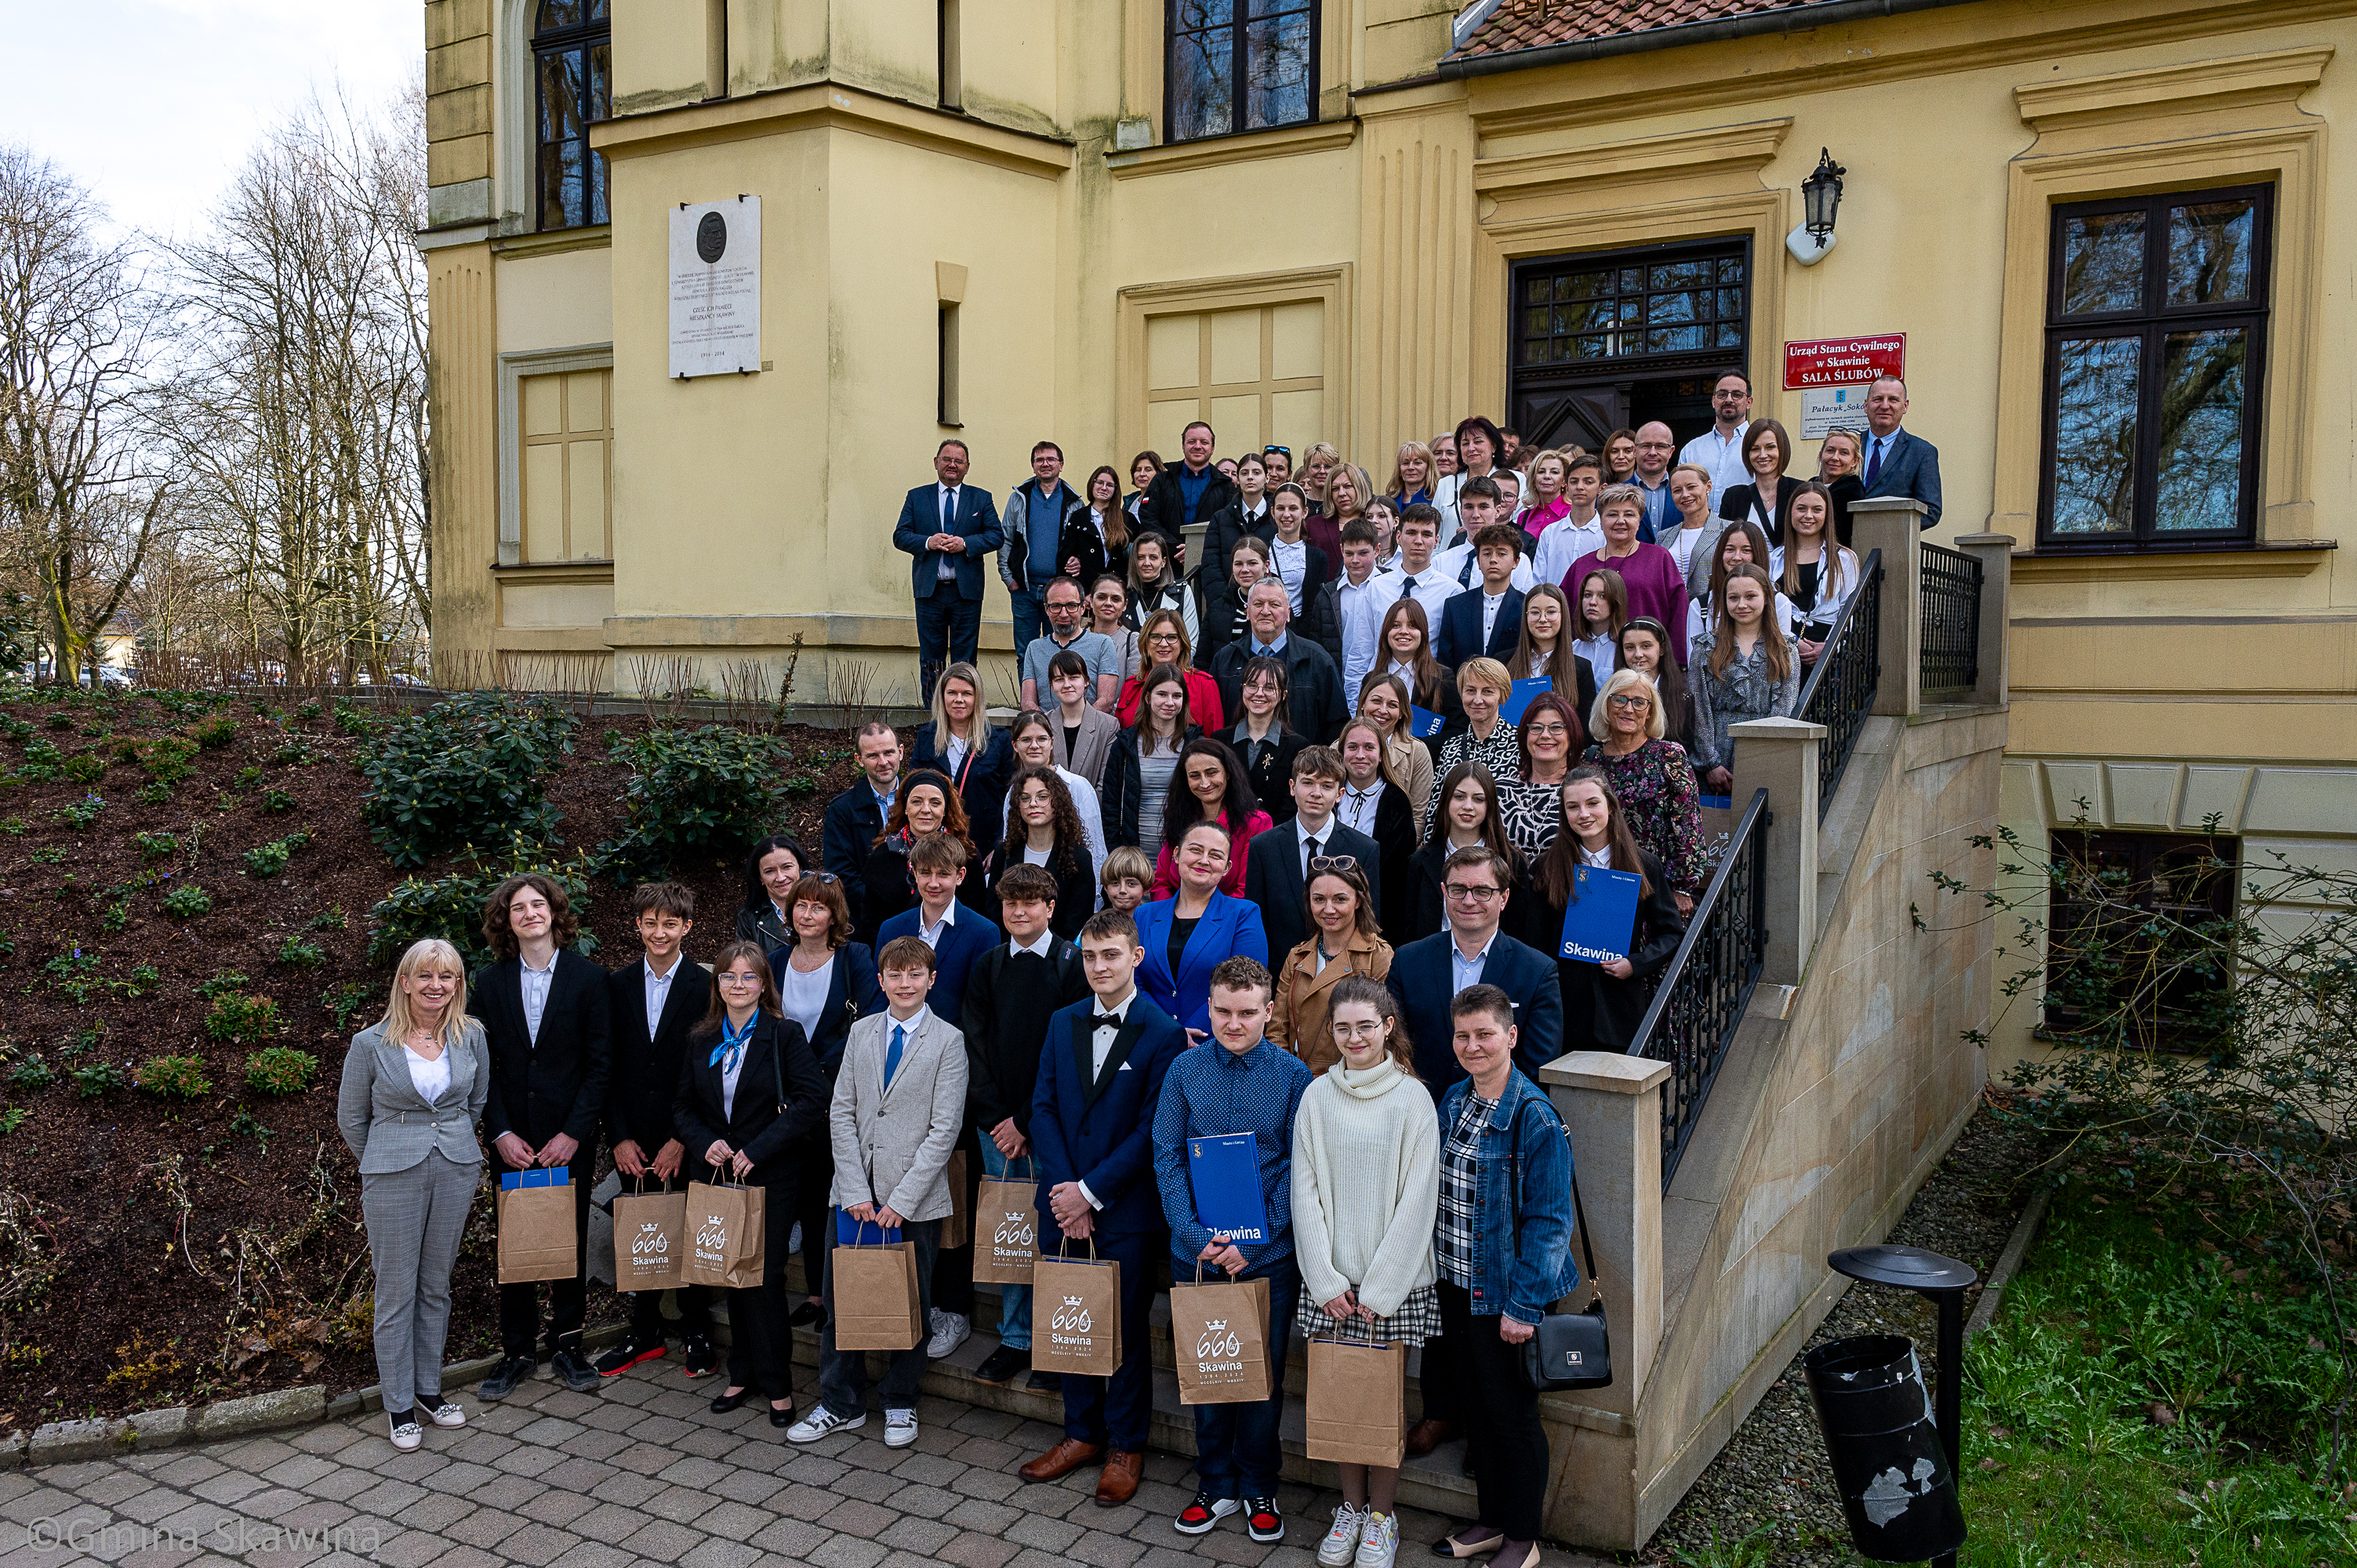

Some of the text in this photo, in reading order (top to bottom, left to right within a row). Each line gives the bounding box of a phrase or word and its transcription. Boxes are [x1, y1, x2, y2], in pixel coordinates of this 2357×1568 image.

[1789, 340, 1900, 357] Urząd Stanu Cywilnego
[1827, 355, 1870, 367] Skawinie
[1802, 367, 1884, 383] SALA ŚLUBÓW
[1811, 405, 1843, 413] Pałacyk
[1428, 717, 1441, 735] ina
[1708, 839, 1729, 858] 66
[1563, 942, 1623, 962] Skawina
[1206, 1226, 1262, 1240] kawina
[695, 1248, 723, 1262] Skawina
[993, 1247, 1033, 1258] Skawina
[633, 1255, 669, 1266] Skawina
[1051, 1333, 1091, 1345] Skawina
[1198, 1361, 1242, 1373] Skawina
